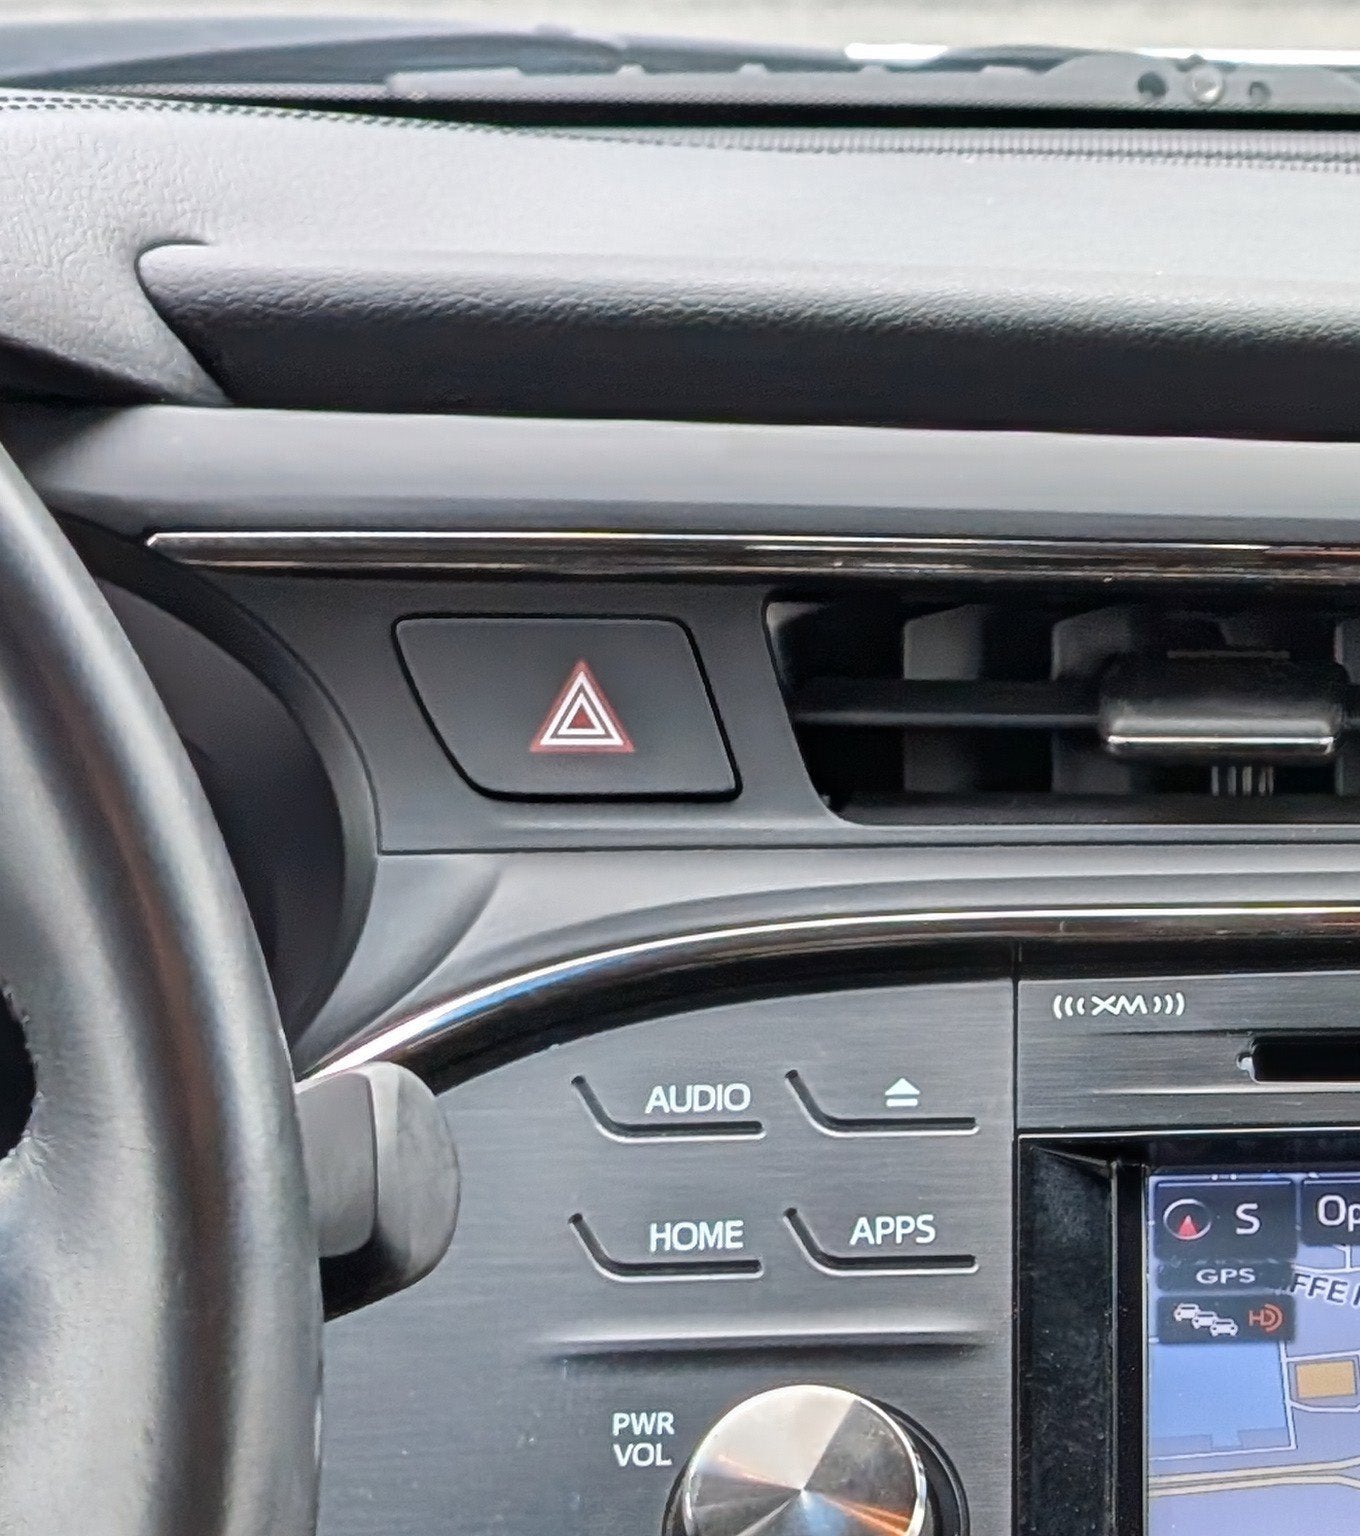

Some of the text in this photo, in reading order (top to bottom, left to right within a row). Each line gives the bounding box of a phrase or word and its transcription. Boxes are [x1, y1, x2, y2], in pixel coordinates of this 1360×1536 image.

[644, 1082, 752, 1114] AUDIO
[848, 1214, 937, 1246] APPS
[1234, 1202, 1262, 1236] S
[649, 1219, 745, 1252] HOME
[1195, 1266, 1257, 1285] GPS
[611, 1410, 676, 1437] PWR
[612, 1442, 673, 1468] VOL
